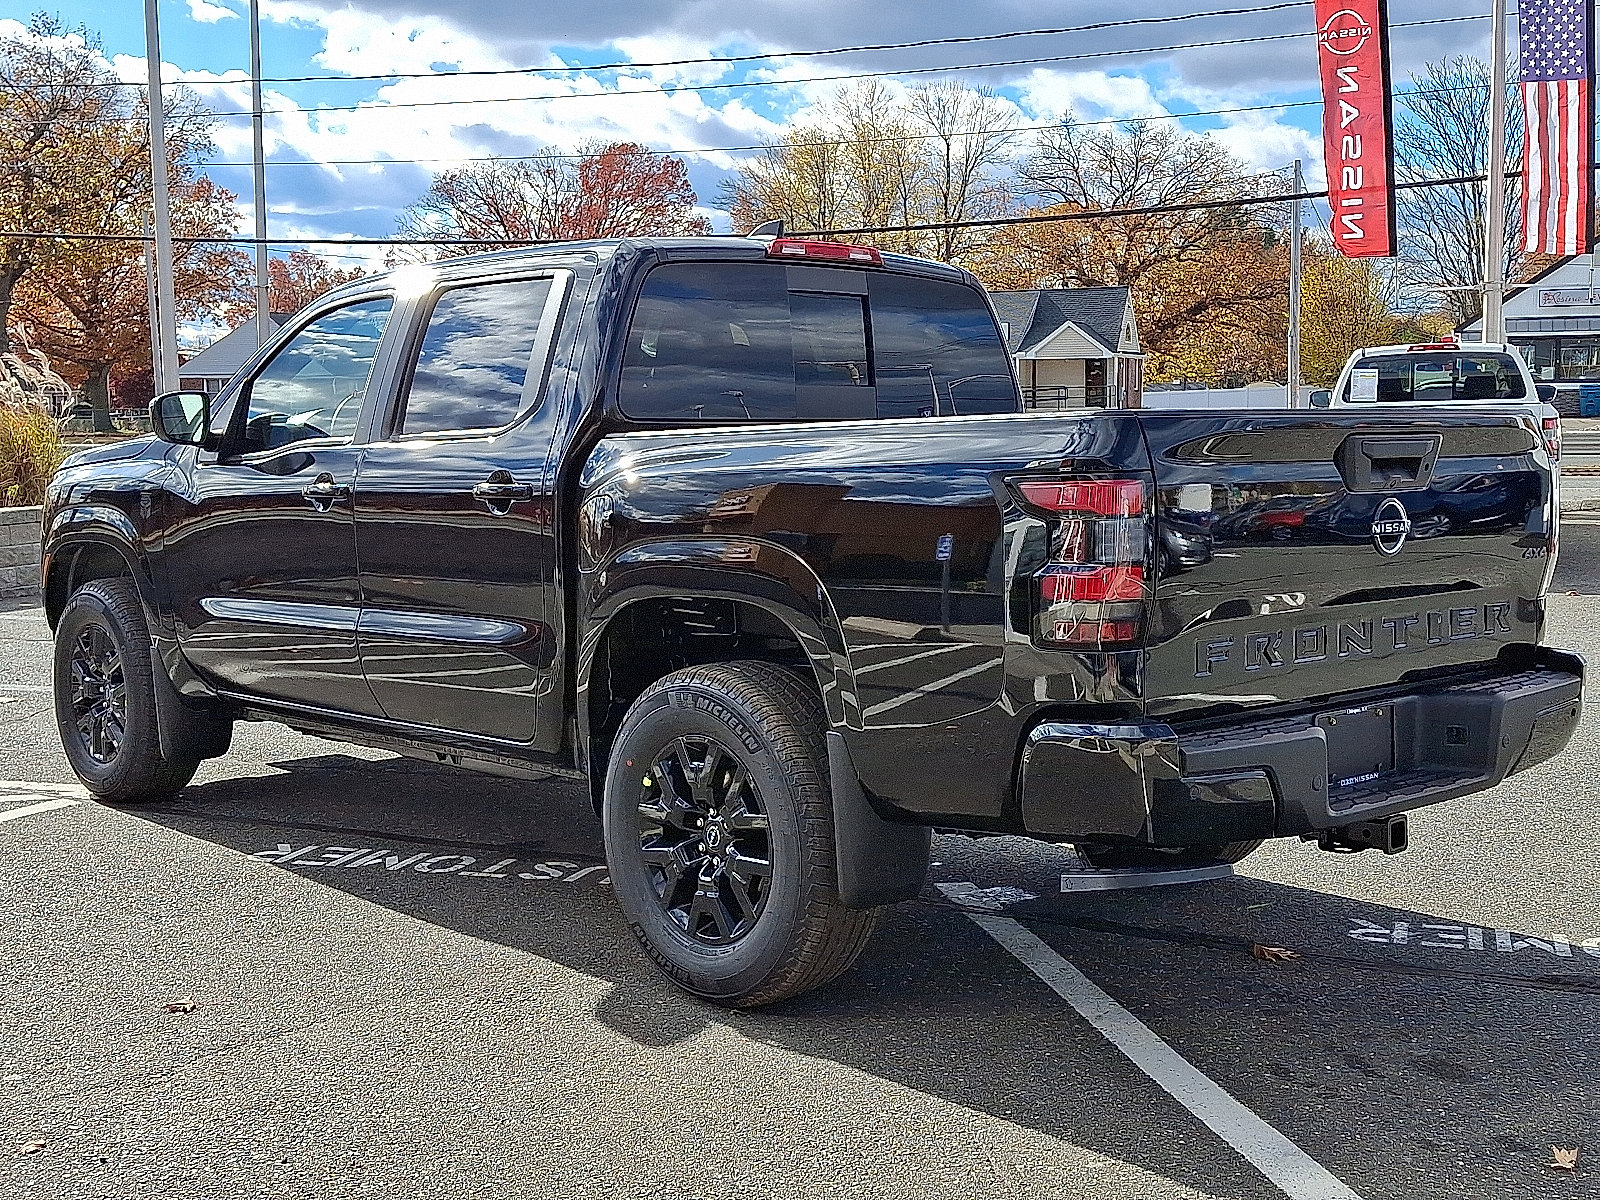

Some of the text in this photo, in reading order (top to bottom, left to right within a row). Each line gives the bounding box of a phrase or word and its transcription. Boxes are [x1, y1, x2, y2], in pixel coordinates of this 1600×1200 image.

[1372, 519, 1412, 534] NISSAN
[1194, 602, 1512, 678] FRONTIER
[695, 696, 760, 750] MICHELIN
[249, 843, 612, 885] USTOMER
[1348, 918, 1600, 958] MER
